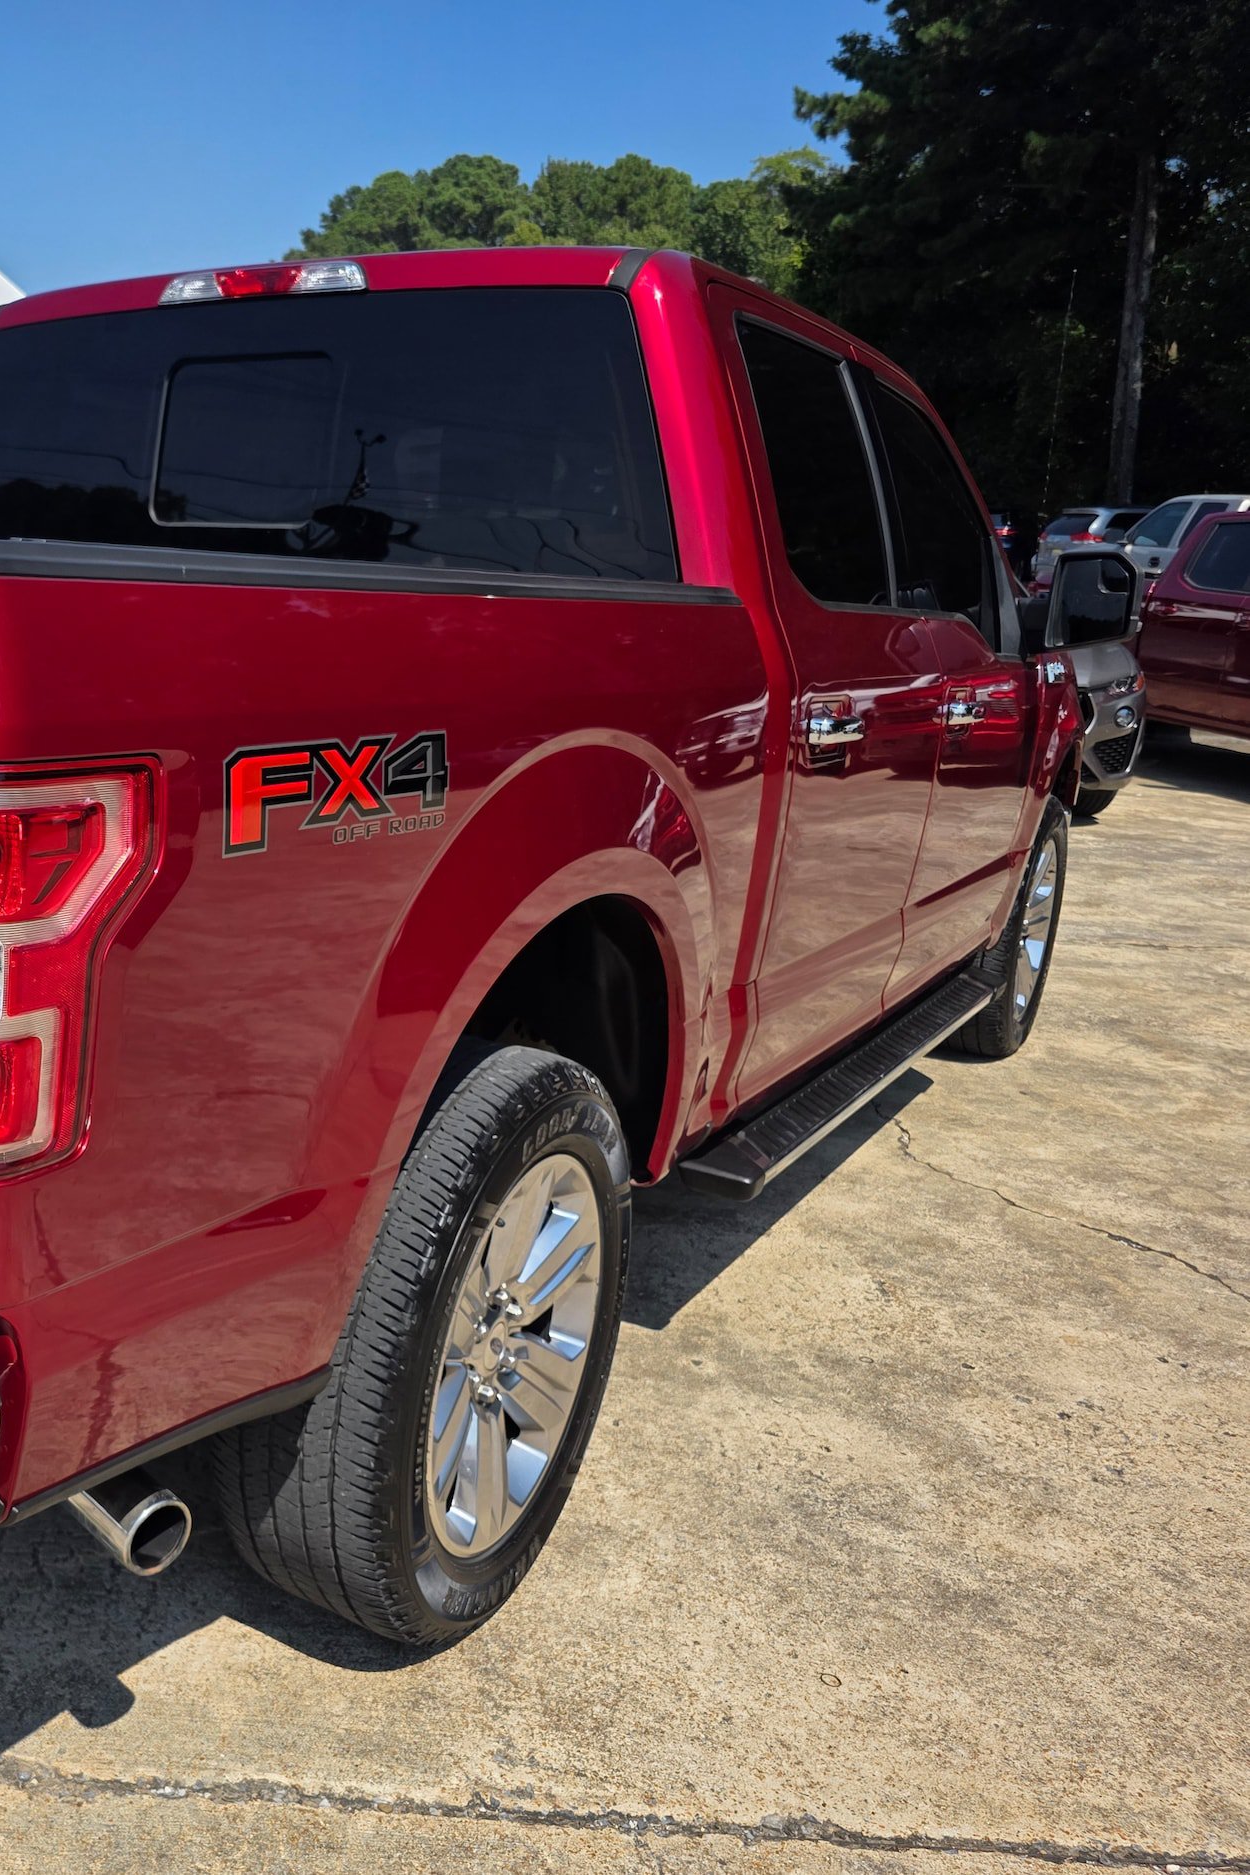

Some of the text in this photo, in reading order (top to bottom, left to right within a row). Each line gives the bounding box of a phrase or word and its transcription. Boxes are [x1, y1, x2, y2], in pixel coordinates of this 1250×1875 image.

[222, 730, 450, 859] FX4
[333, 812, 446, 845] OFF ROAD
